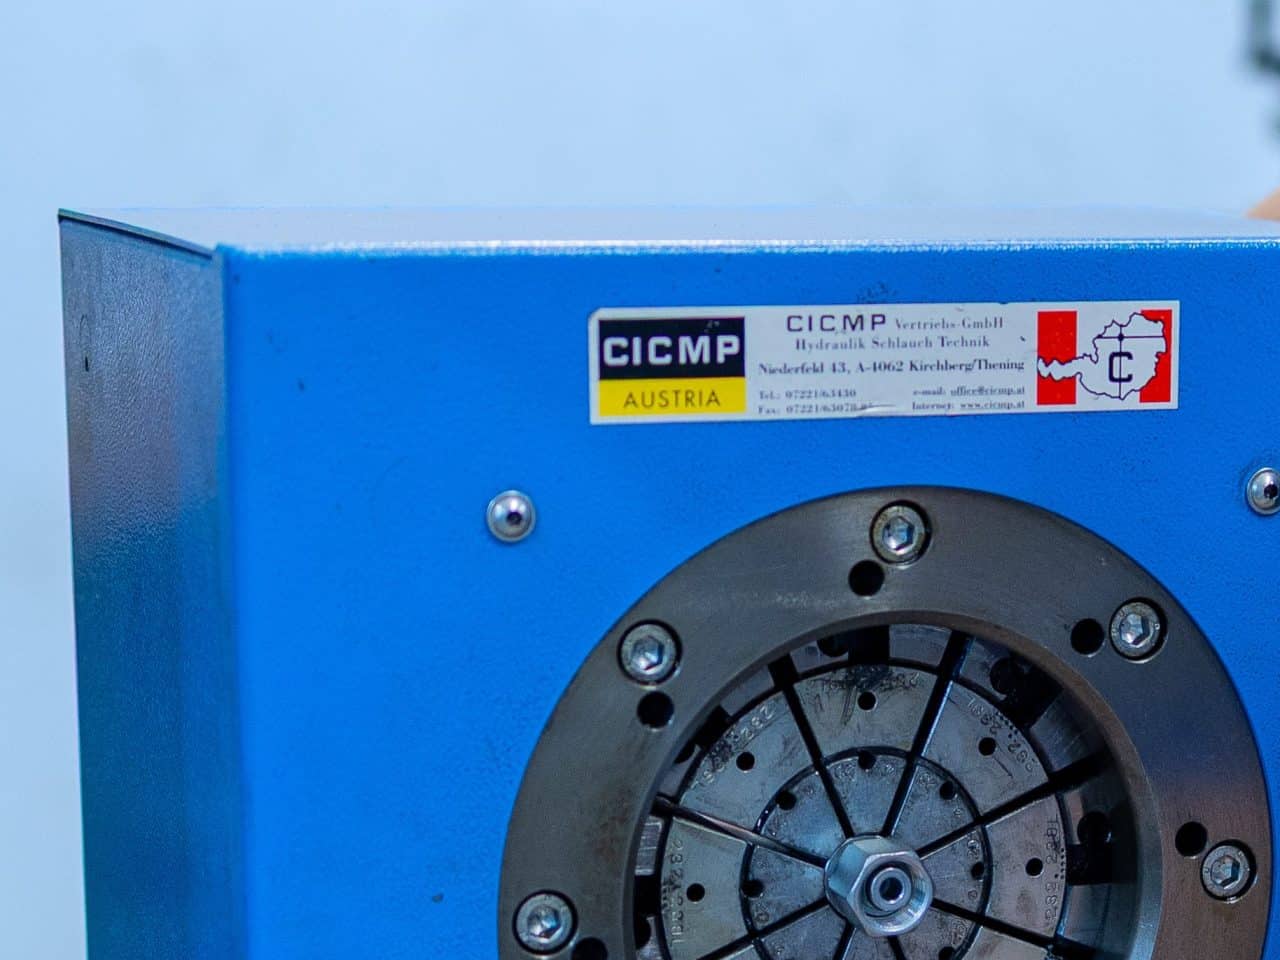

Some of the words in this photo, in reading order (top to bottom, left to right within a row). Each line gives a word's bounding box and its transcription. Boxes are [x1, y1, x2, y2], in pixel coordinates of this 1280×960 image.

[787, 314, 886, 332] CICMP
[603, 334, 741, 367] CICMP
[796, 338, 865, 354] Hydraulik
[872, 337, 932, 350] Schlauch
[938, 335, 990, 348] Technik
[759, 361, 824, 374] Niederfeld
[856, 360, 904, 373] A-4062
[909, 359, 1025, 372] Kirchberg/Thening
[623, 389, 721, 409] AUSTRIA
